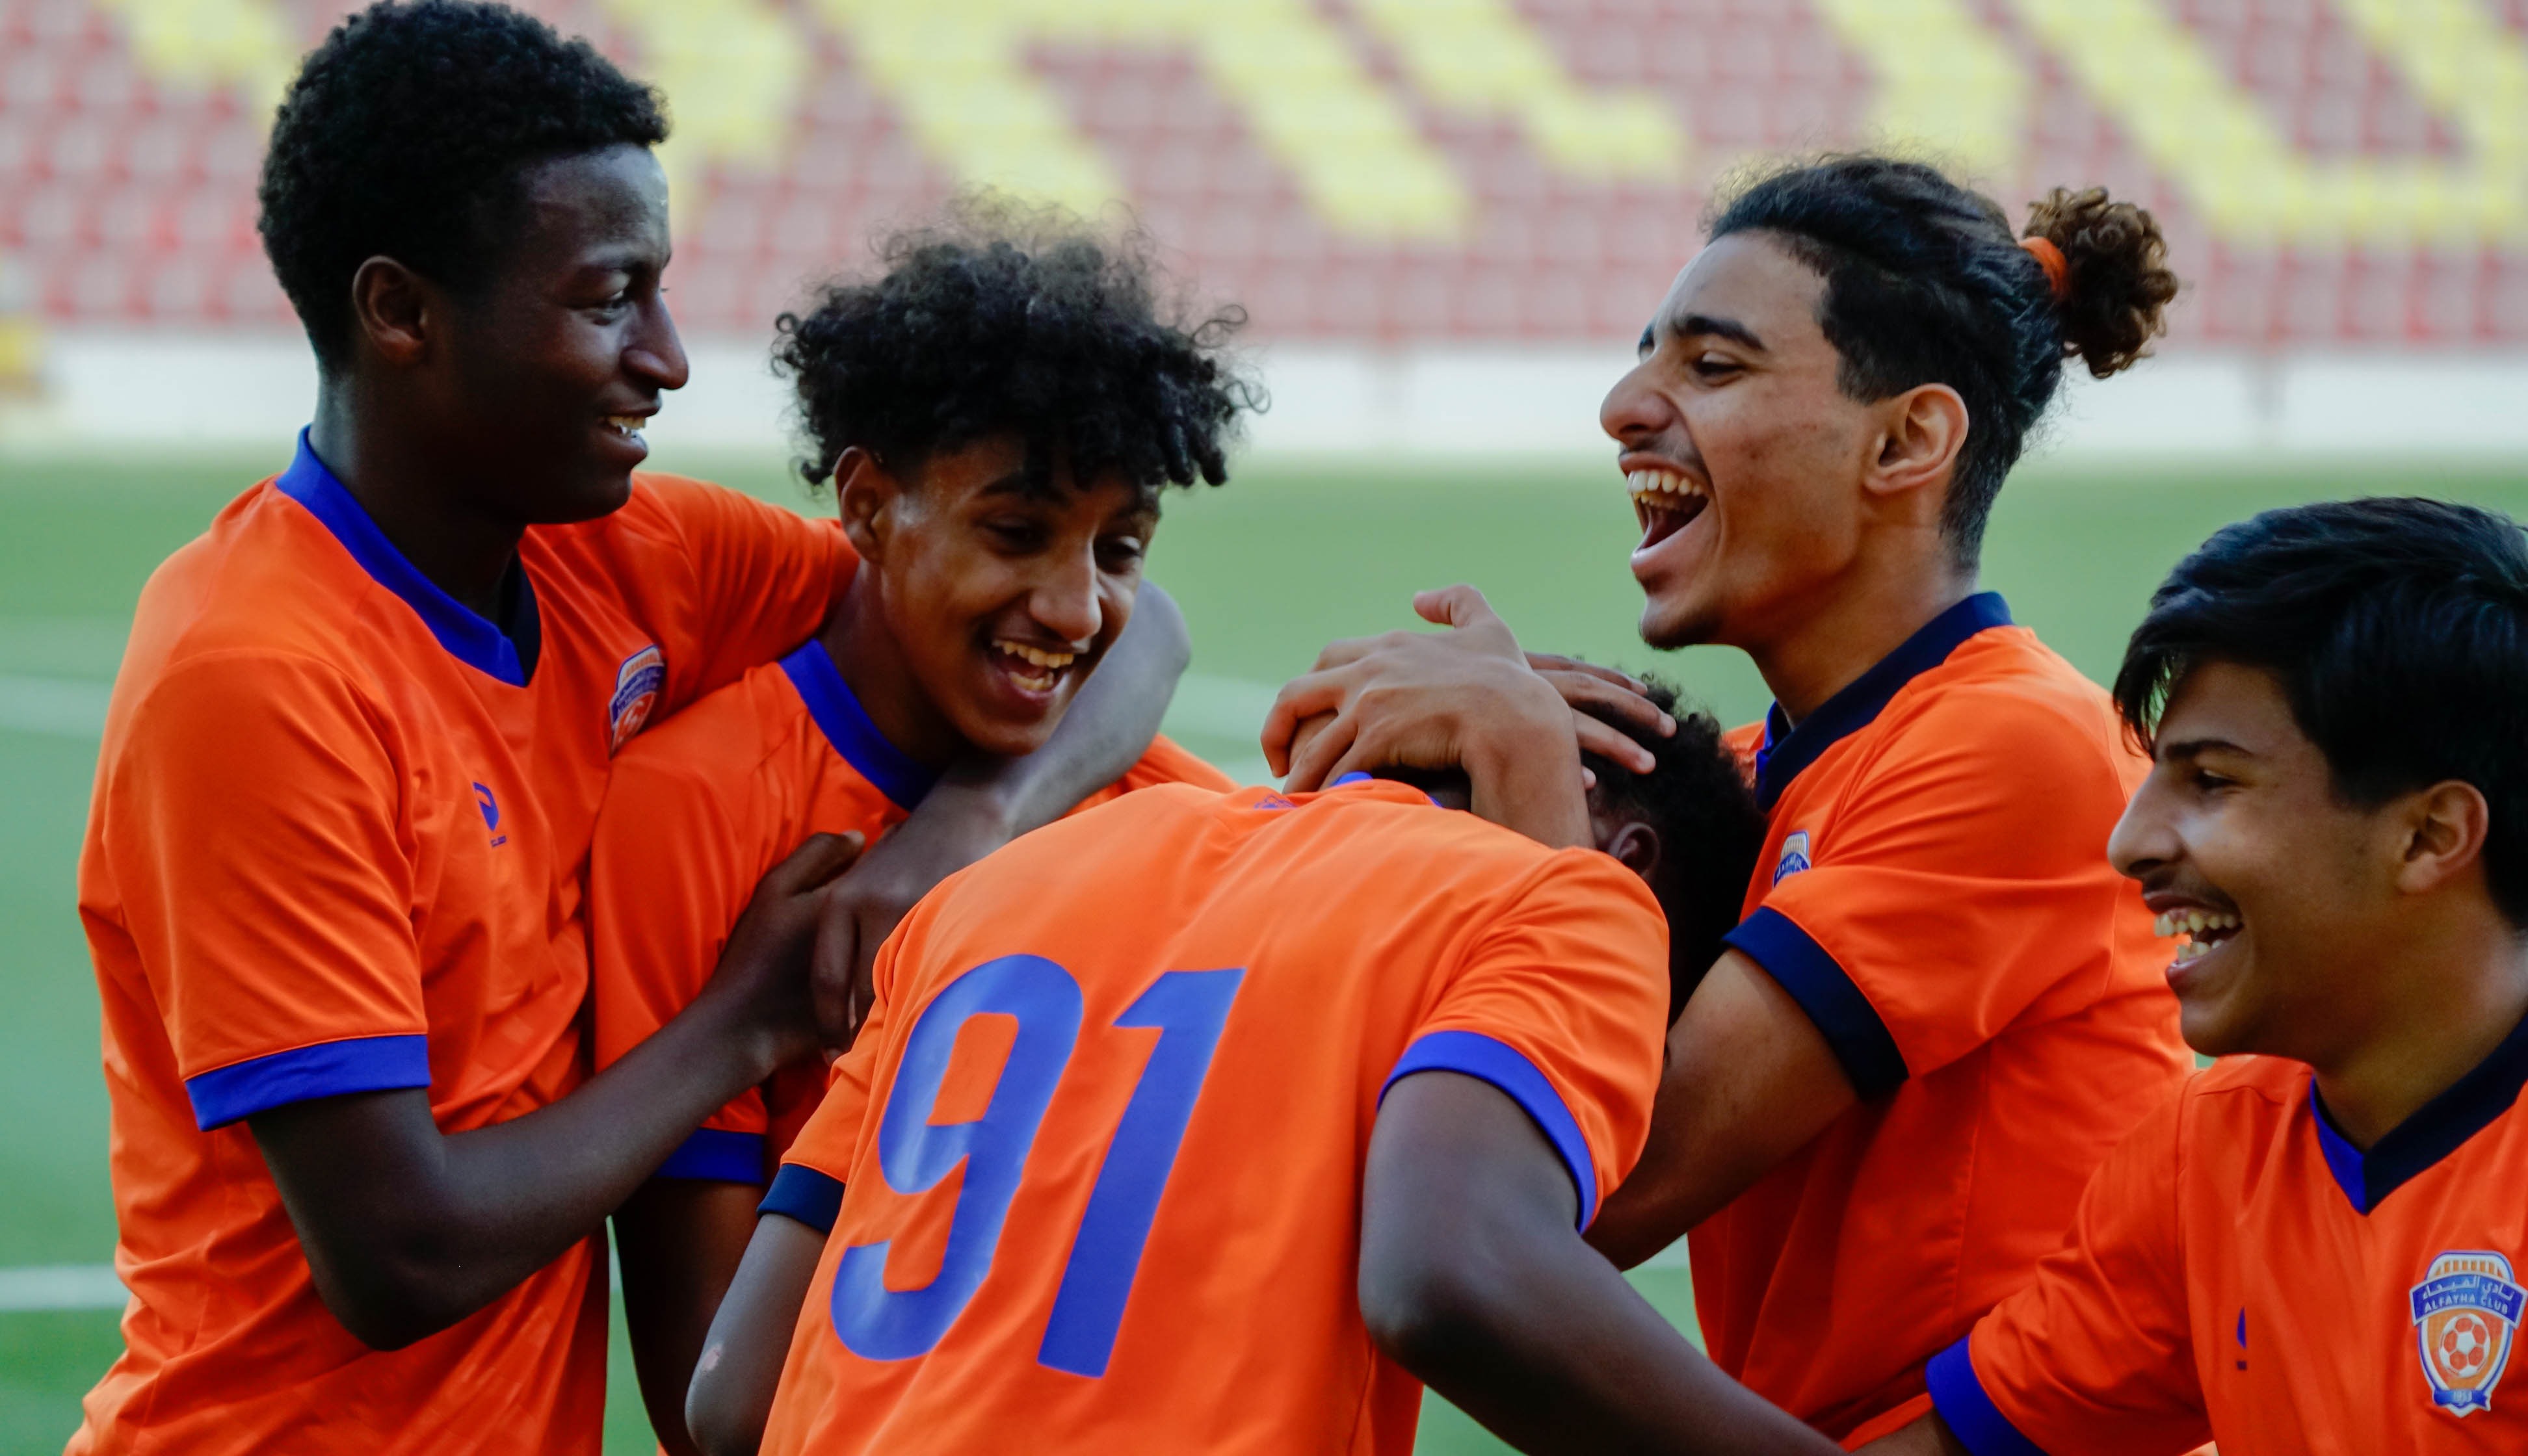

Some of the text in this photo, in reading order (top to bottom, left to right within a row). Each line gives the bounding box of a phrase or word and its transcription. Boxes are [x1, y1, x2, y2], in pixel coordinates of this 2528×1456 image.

[831, 954, 1247, 1378] 91
[2425, 1294, 2508, 1314] ALFAYHA CLUB
